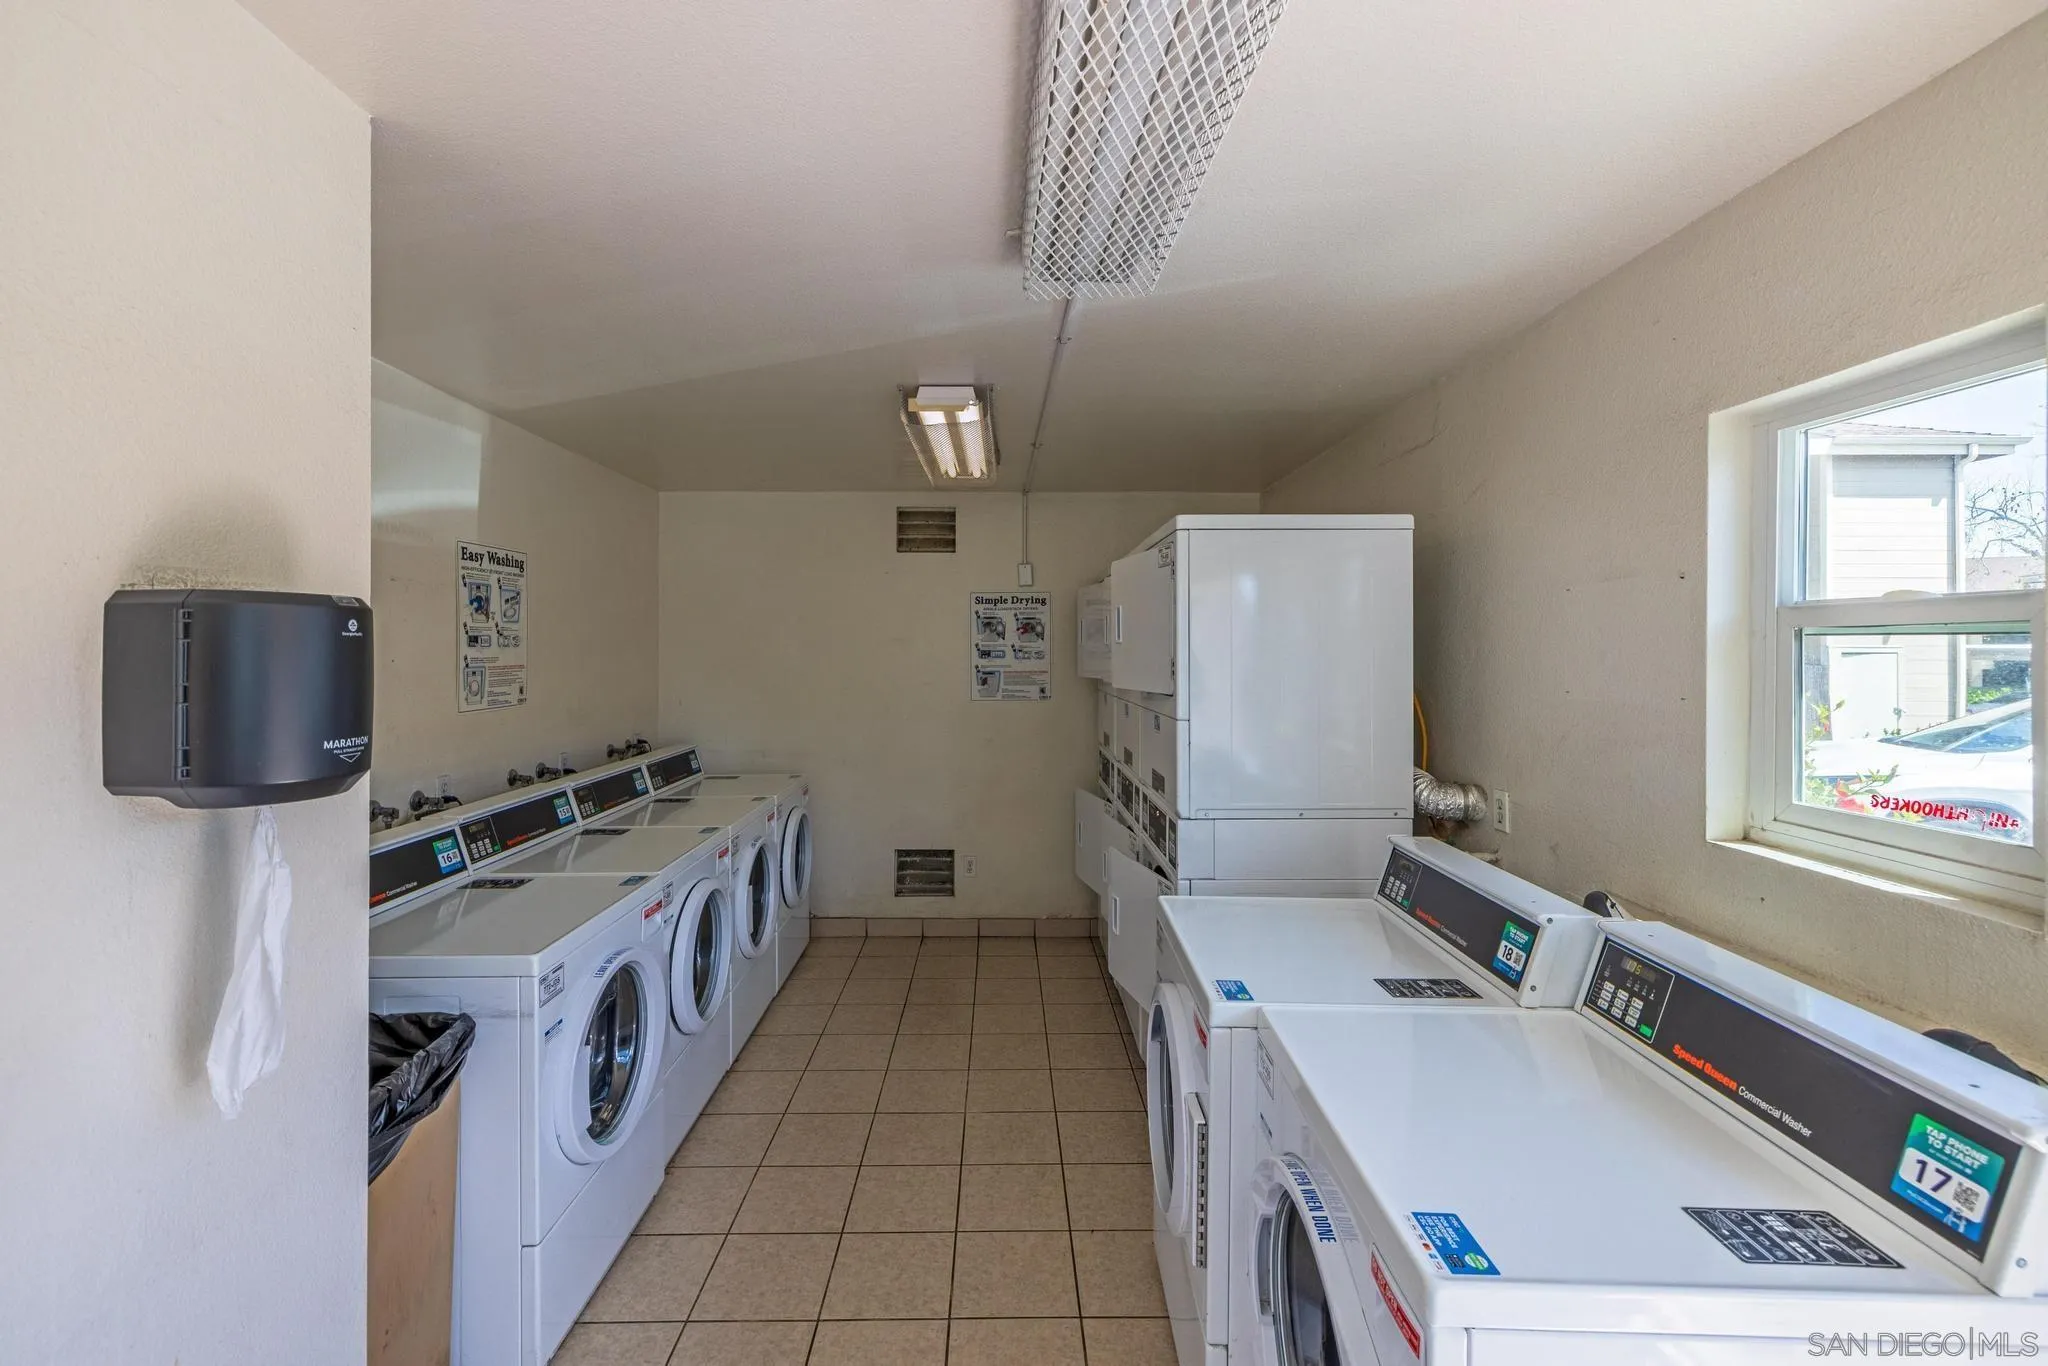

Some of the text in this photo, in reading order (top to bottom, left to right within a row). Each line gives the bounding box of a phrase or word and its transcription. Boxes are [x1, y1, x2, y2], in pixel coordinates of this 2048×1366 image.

[461, 546, 485, 567] Easy
[486, 550, 525, 573] Washing
[975, 596, 1047, 607] Simple Drying
[323, 735, 369, 750] MARATHON
[441, 853, 453, 865] 16
[1501, 944, 1514, 961] 18
[1672, 1043, 1813, 1138] Speed Queen Commercial Washer
[1926, 1124, 1947, 1140] TAP
[1947, 1136, 1990, 1165] PHONE
[1927, 1134, 1943, 1149] TO
[1943, 1144, 1982, 1170] START
[1915, 1158, 1953, 1193] 17
[1299, 1188, 1325, 1212] WHEN
[1311, 1215, 1337, 1243] DONE
